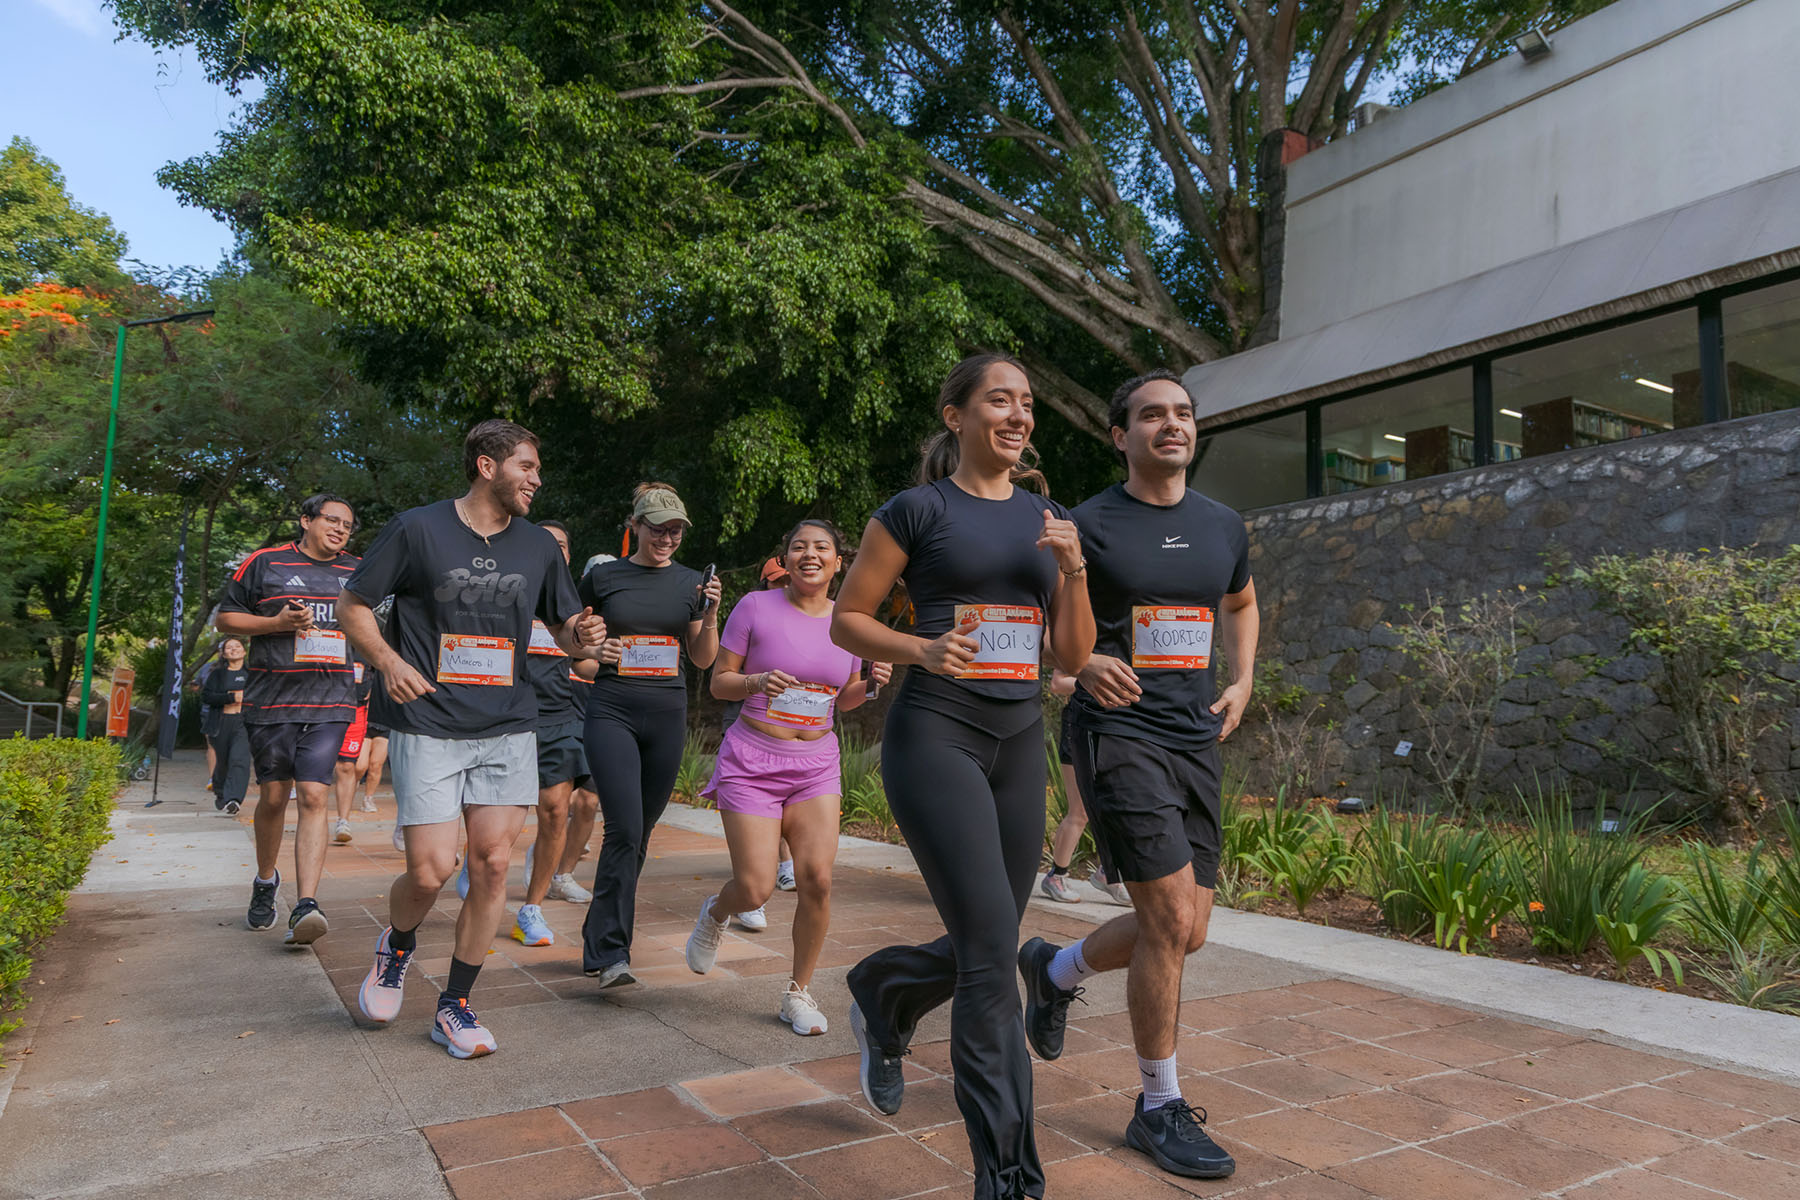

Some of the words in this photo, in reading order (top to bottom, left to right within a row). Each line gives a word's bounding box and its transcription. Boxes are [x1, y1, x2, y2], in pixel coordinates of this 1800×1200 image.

[472, 556, 497, 571] GO
[980, 629, 1016, 652] Nai
[1151, 628, 1208, 649] RODRIGO
